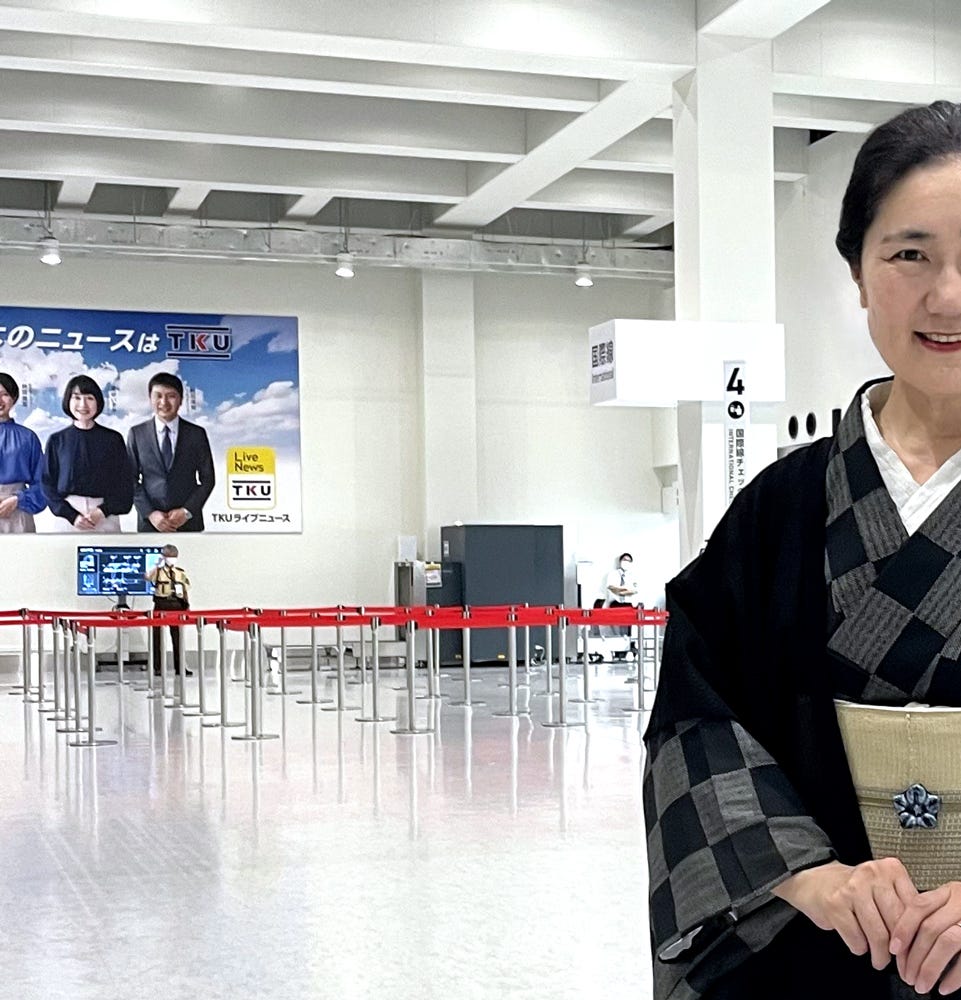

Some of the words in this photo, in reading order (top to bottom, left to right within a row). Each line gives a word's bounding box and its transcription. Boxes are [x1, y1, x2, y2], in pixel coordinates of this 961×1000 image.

[166, 331, 231, 352] TKU
[726, 367, 745, 395] 4
[234, 451, 259, 462] Live
[234, 462, 265, 473] News
[232, 485, 271, 497] TKU
[211, 513, 291, 523] TKUライブニュース
